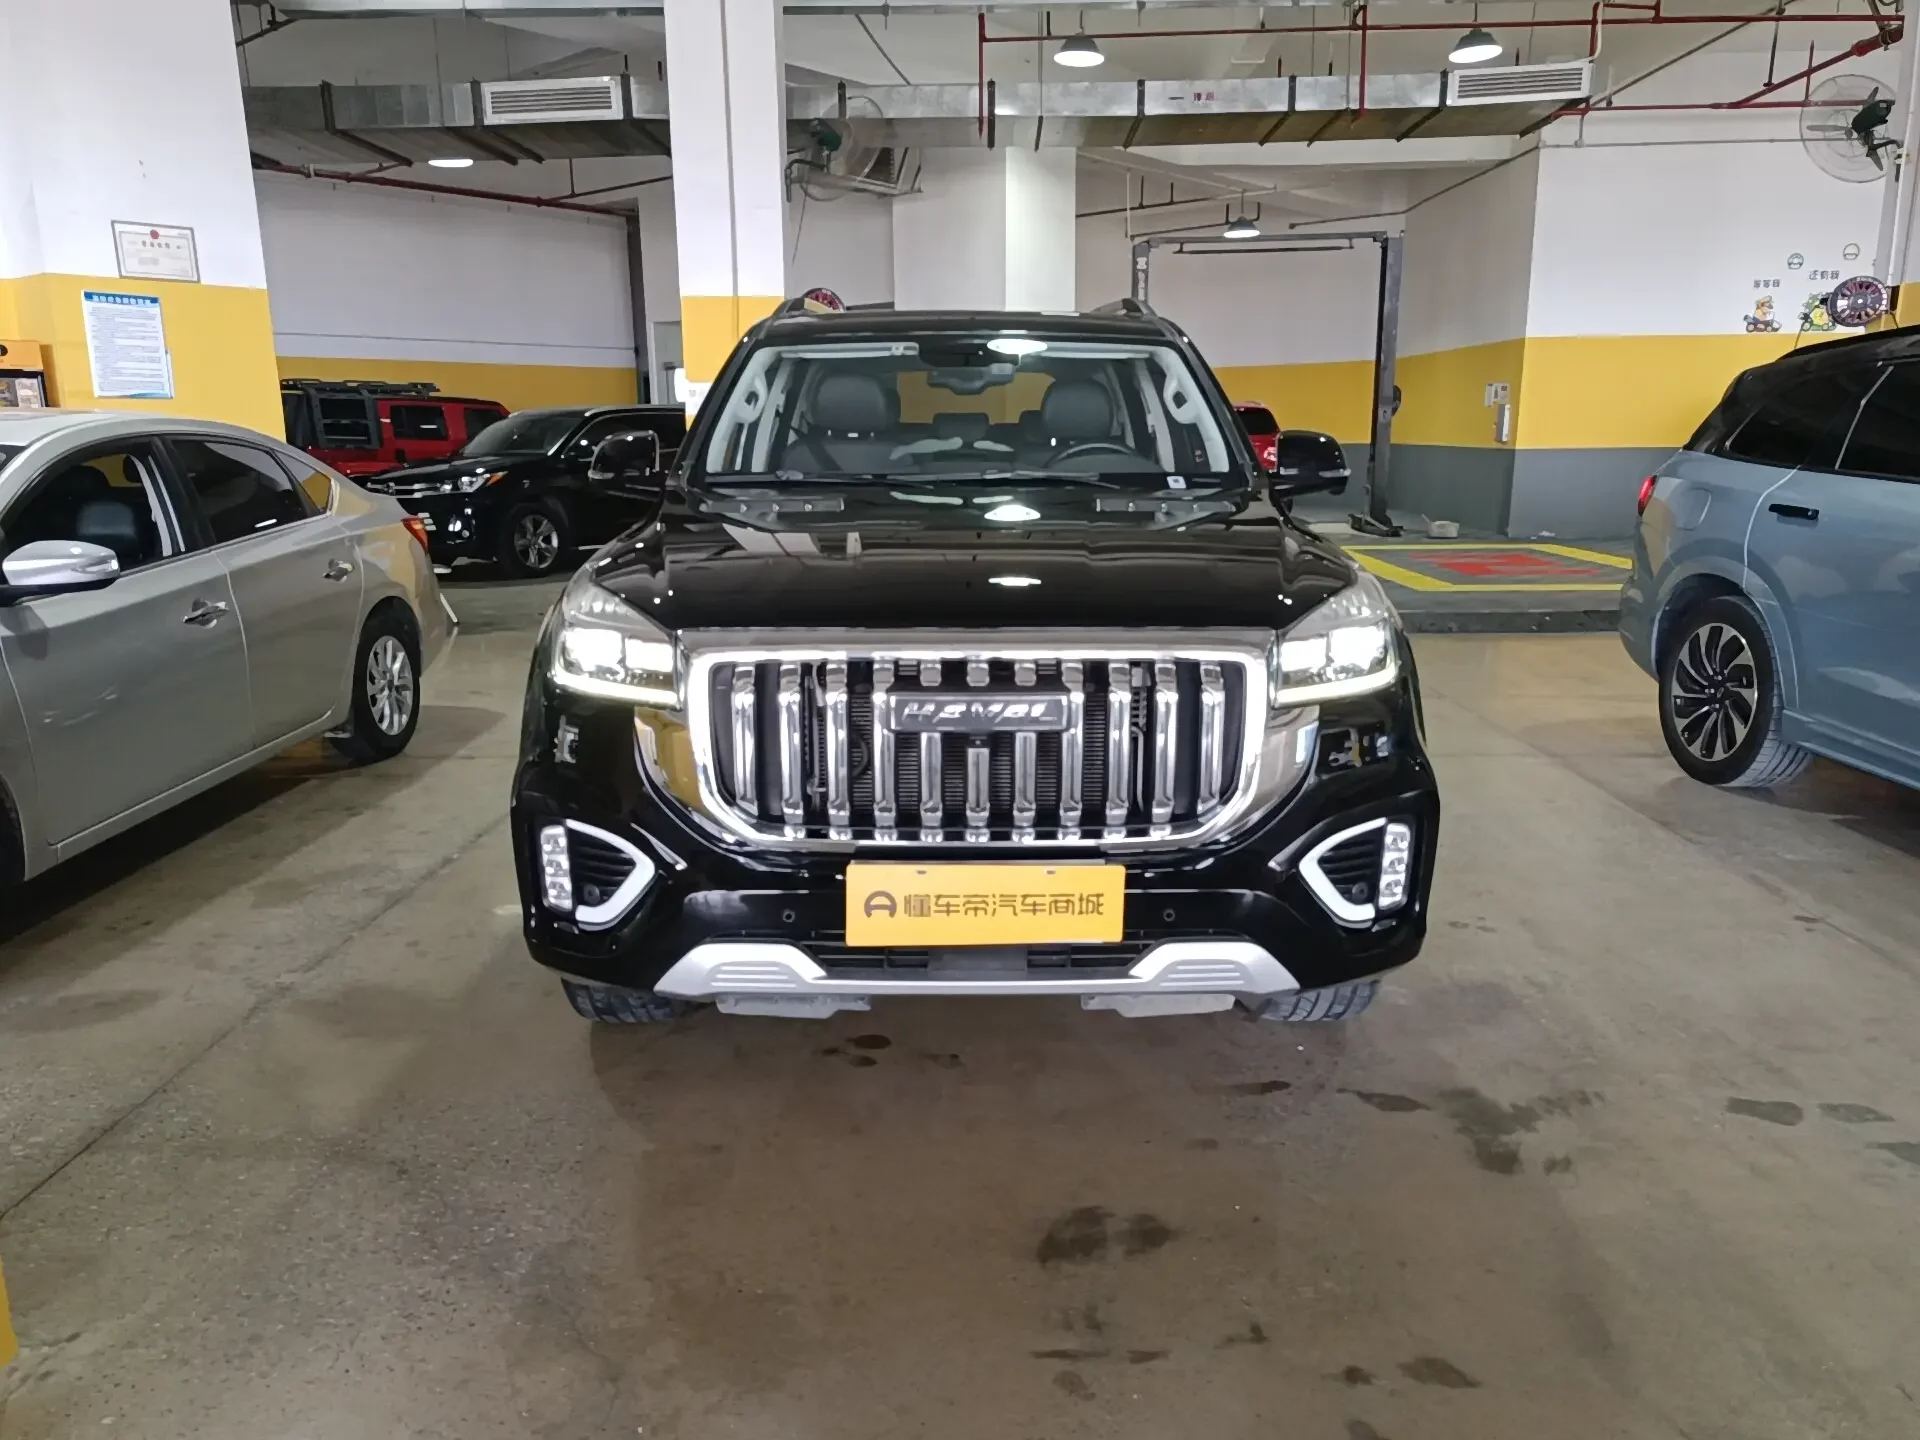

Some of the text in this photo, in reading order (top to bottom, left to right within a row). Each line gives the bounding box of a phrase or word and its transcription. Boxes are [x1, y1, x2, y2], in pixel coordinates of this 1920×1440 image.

[903, 893, 1105, 918] 懂车帝汽车商城
